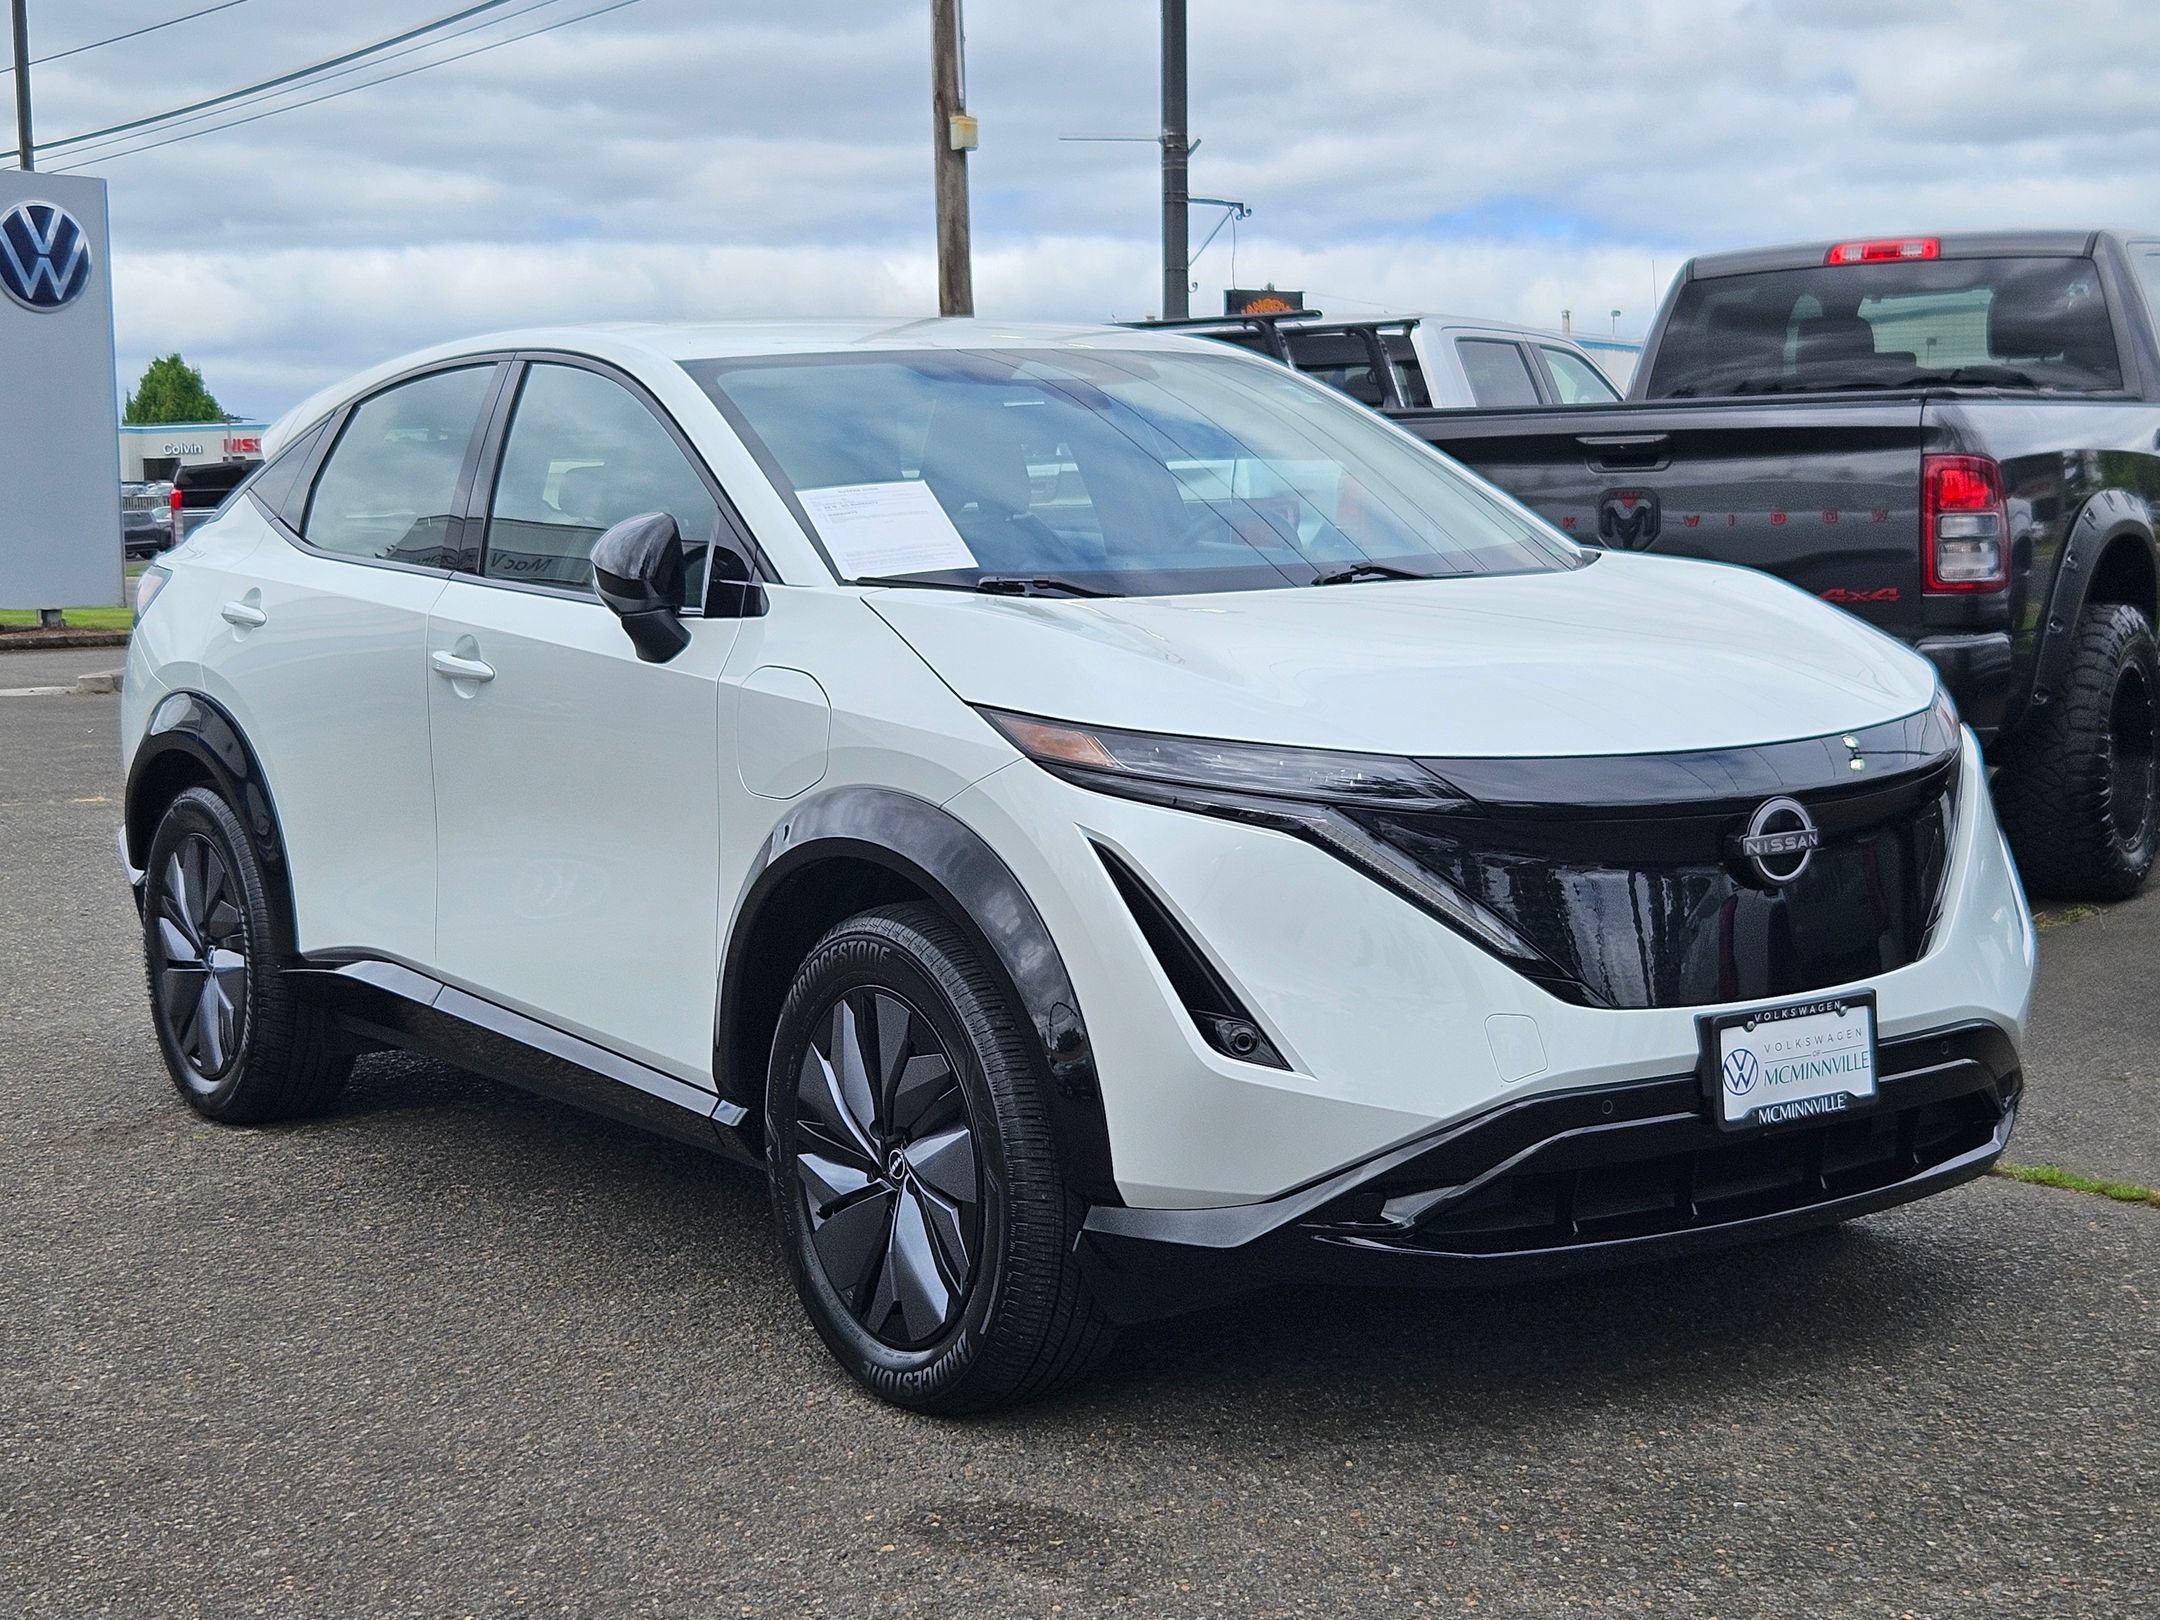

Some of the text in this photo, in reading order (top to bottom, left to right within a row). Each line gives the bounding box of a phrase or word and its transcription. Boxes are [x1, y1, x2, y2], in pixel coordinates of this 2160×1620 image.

[163, 443, 203, 455] Colvin
[223, 438, 262, 453] NISS
[1683, 508, 1889, 529] WIDOW
[1746, 834, 1818, 854] NISSAN
[788, 940, 891, 1014] BRIDGESTONE
[1754, 1001, 1841, 1023] VOLKSWAGEN
[1764, 1028, 1863, 1054] VOLKSWAGEN
[1764, 1050, 1870, 1088] MCMINNVILLE
[1758, 1094, 1847, 1125] MCMINNVILLE
